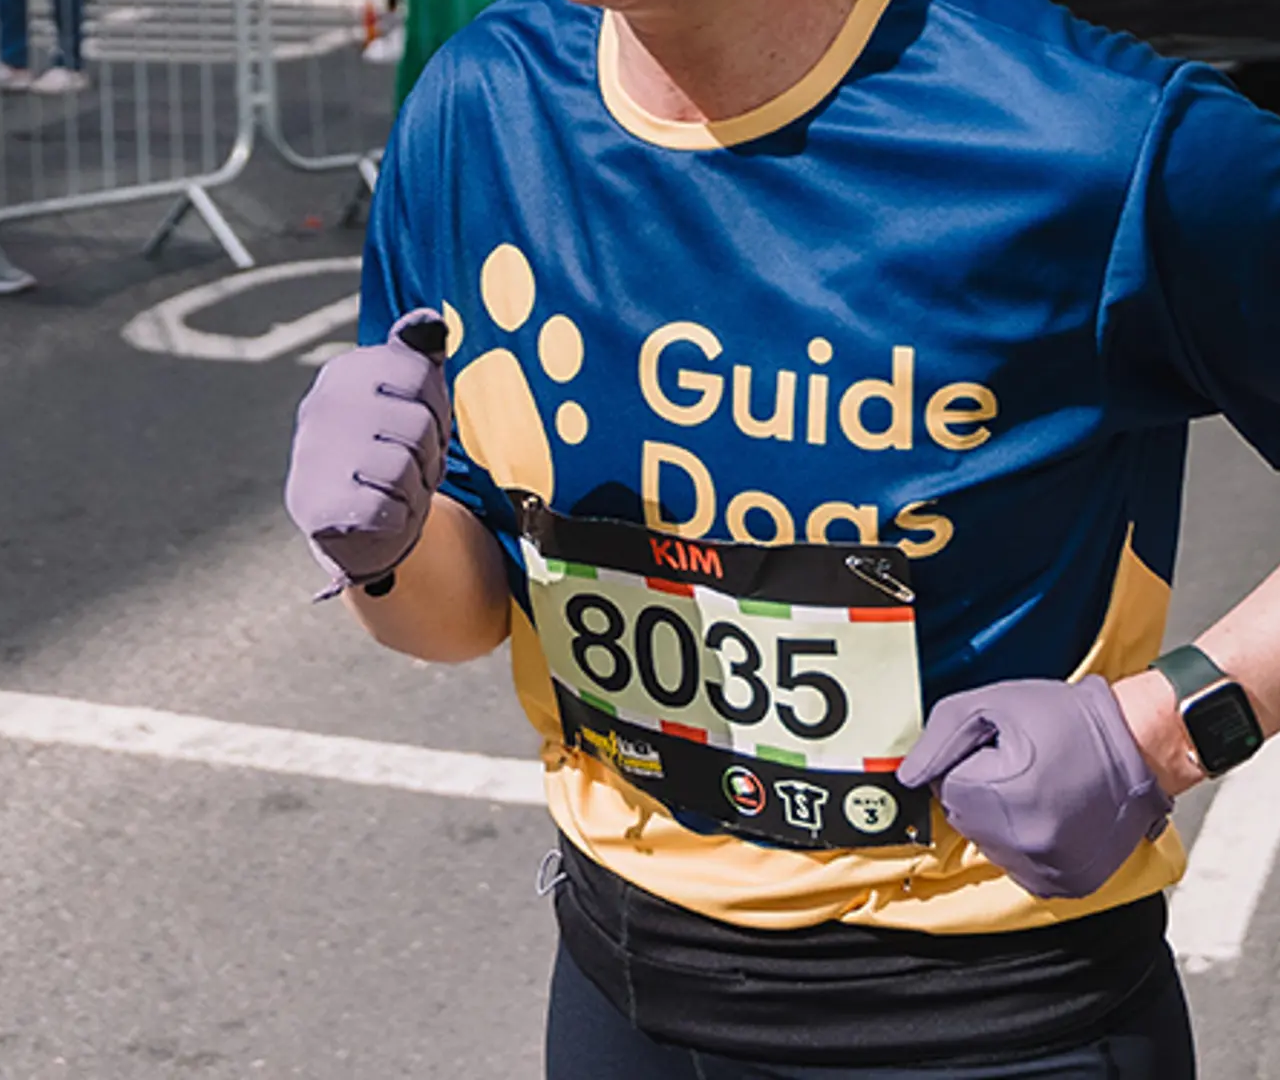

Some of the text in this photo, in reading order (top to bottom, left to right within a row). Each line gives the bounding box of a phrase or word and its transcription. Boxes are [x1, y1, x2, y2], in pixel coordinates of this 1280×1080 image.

[638, 321, 998, 451] Guide
[649, 538, 723, 579] KIM
[565, 593, 848, 740] 8035
[864, 808, 878, 825] 3
